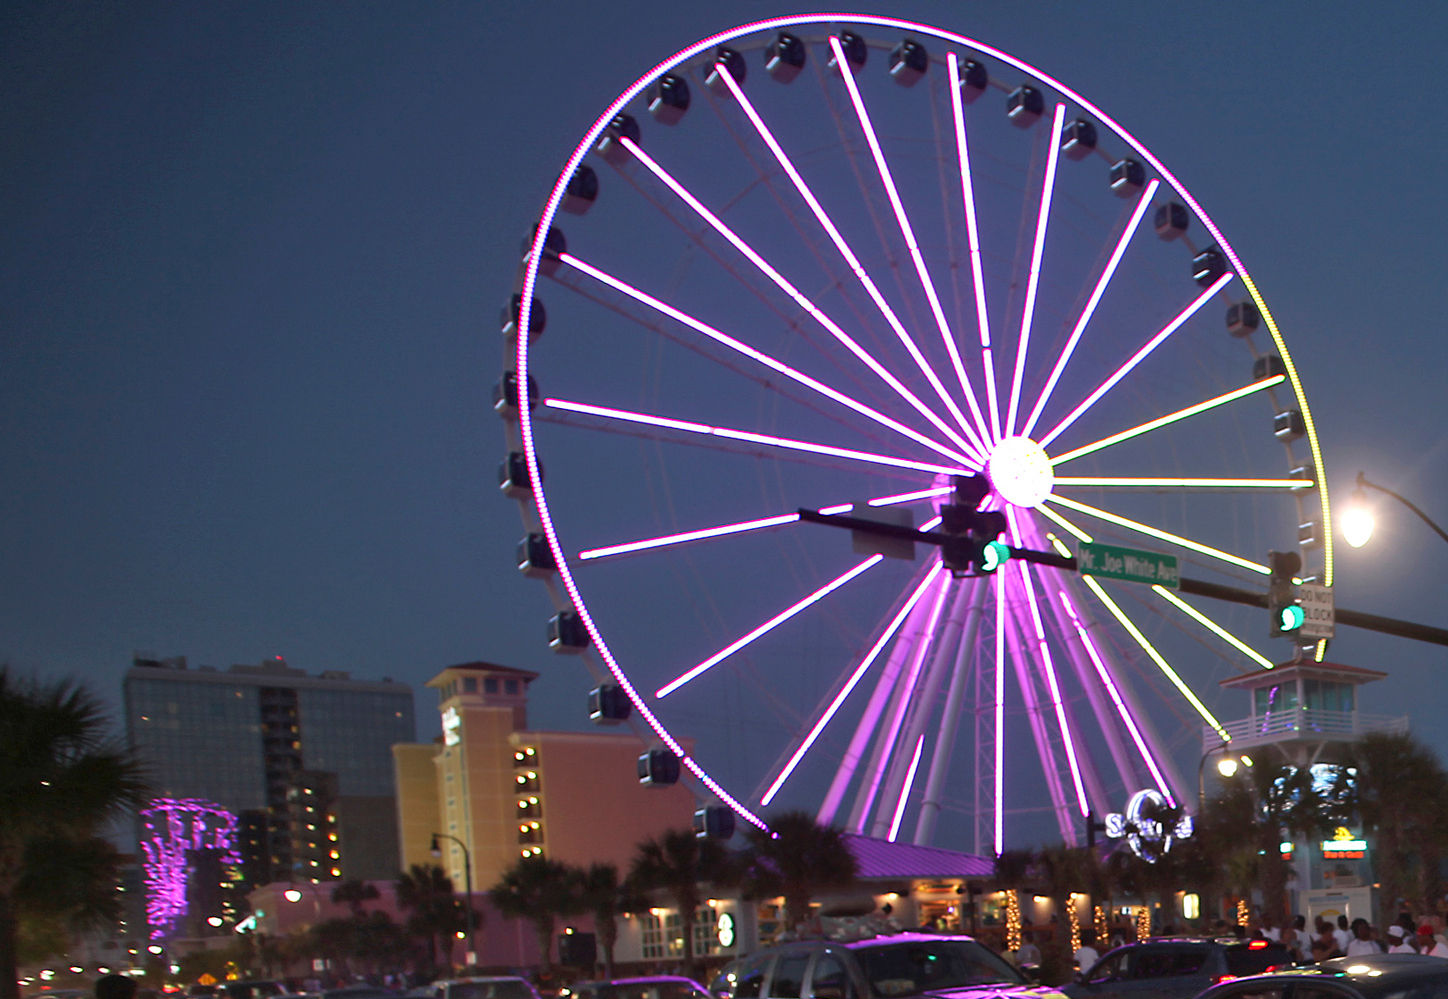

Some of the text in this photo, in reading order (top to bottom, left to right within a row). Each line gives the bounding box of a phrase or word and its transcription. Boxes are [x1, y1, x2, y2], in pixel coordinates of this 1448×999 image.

[1081, 549, 1178, 582] Mr. Joe White Ave
[1301, 589, 1332, 603] DO NOT
